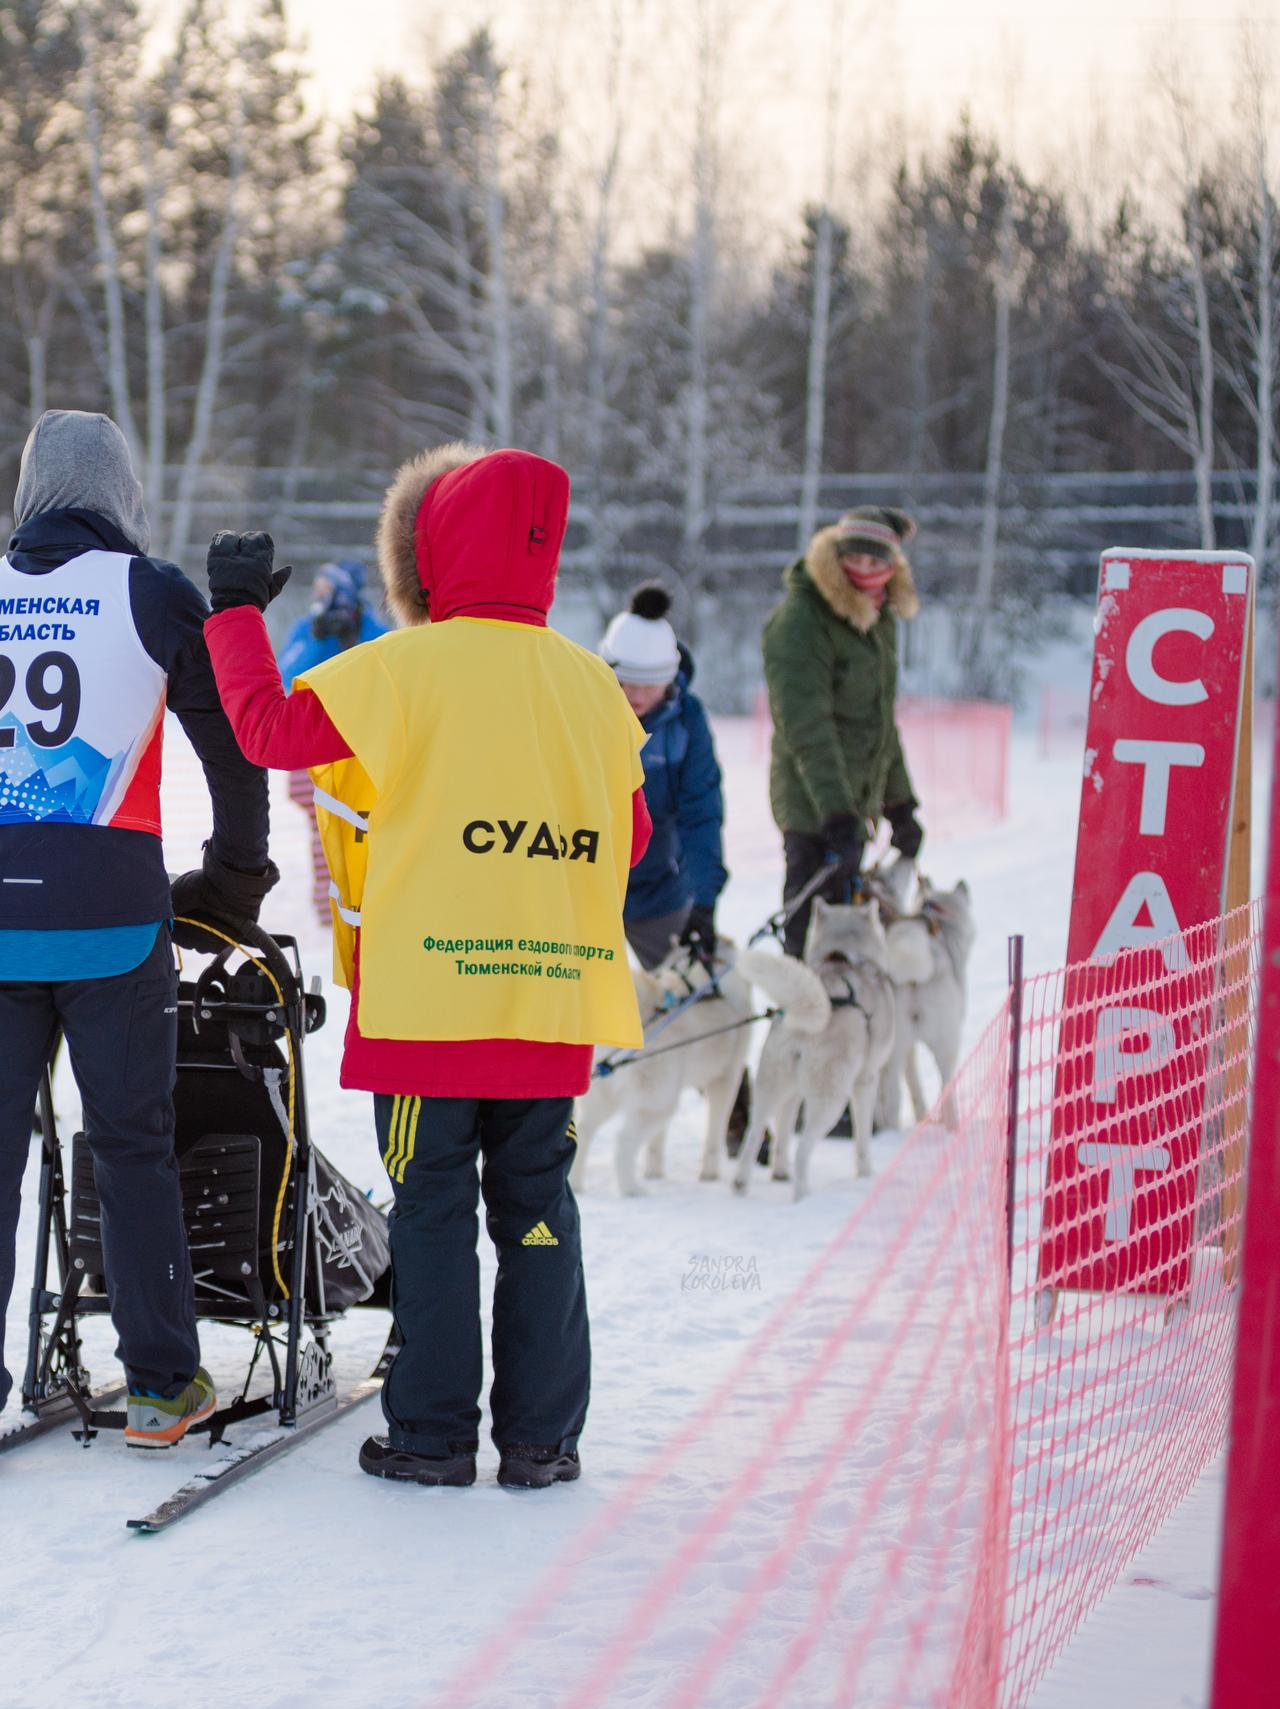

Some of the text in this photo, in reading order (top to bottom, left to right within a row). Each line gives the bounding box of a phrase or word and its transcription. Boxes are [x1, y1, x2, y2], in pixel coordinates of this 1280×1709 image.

[1077, 608, 1216, 1242] СТАРТ
[423, 936, 513, 954] Федерация
[455, 959, 542, 976] Тюменской
[521, 1236, 559, 1246] adidas
